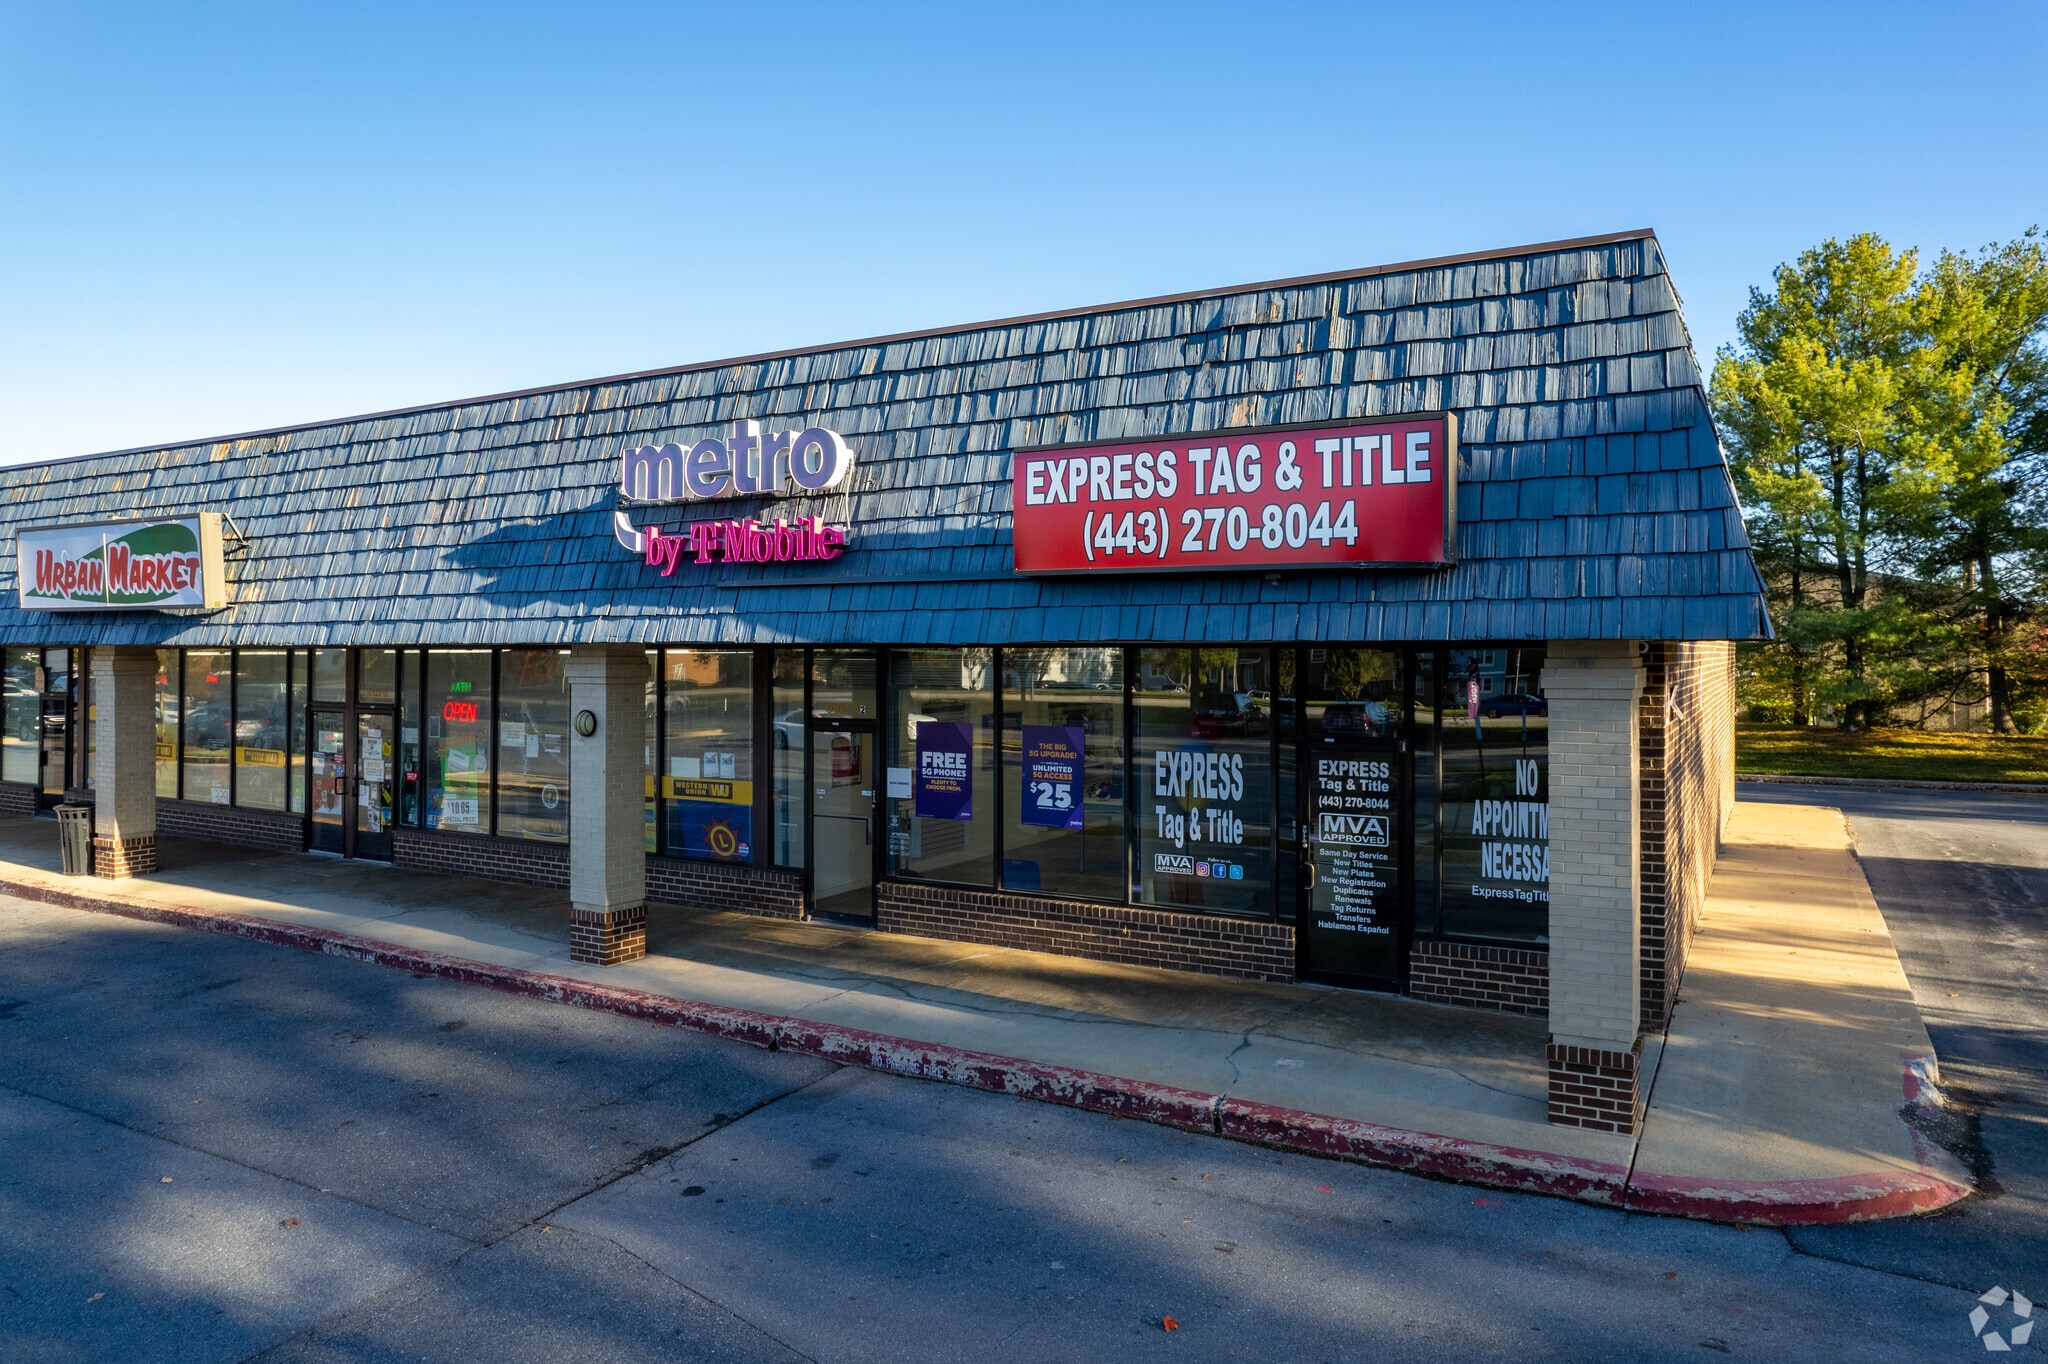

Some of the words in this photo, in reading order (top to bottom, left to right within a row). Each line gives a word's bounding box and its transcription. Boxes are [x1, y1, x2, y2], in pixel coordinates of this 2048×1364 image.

[623, 419, 842, 500] metro
[1025, 450, 1178, 506] EXPRESS
[1188, 442, 1262, 496] TAG
[1275, 440, 1302, 492] &
[1314, 431, 1431, 488] TITLE
[1083, 507, 1170, 562] (443)
[1181, 500, 1359, 552] 270-8044
[645, 525, 688, 577] by
[36, 549, 103, 598] URBAN
[109, 545, 200, 592] MARKET
[444, 701, 478, 723] OPEN
[1039, 742, 1053, 750] THE
[1054, 743, 1067, 751] BIG
[922, 751, 967, 769] FREE
[1040, 751, 1077, 759] UPGRADE!
[922, 767, 933, 775] 5G
[933, 768, 967, 777] PHONES
[1032, 764, 1073, 774] UNLIMITED
[1318, 760, 1390, 779] EXPRESS
[1043, 772, 1073, 781] ACCESS
[1155, 751, 1244, 801] EXPRESS
[1515, 759, 1539, 797] NO
[675, 781, 708, 790] WESTERN
[1318, 777, 1343, 792] Tag
[1346, 778, 1356, 791] &
[1360, 779, 1390, 792] Title
[685, 788, 707, 796] UNION
[1030, 781, 1072, 809] $25
[1318, 795, 1343, 809] (443)
[1345, 796, 1390, 810] 270-8044
[1155, 805, 1185, 848] Tag
[1189, 807, 1202, 842] &
[1206, 808, 1244, 845] Title
[1324, 815, 1385, 836] MVA
[1323, 833, 1385, 844] APPROVED
[1319, 848, 1341, 857] Same
[1342, 850, 1357, 860] Day
[1359, 851, 1389, 861] Service
[1157, 855, 1192, 868] MVA
[1333, 858, 1350, 867] New
[1352, 859, 1374, 869] Titles
[1157, 866, 1192, 874] APPROVED
[1332, 867, 1349, 876] New
[1351, 868, 1375, 878] Plates
[1321, 875, 1338, 883] New
[1339, 877, 1387, 888] Registration
[1333, 885, 1374, 897] Duplicates
[1334, 894, 1372, 906] Renewals
[1330, 903, 1344, 913] Tag
[1346, 904, 1377, 915] Returns
[1335, 912, 1372, 924] Transfers
[1317, 920, 1356, 931] Hablamos
[1357, 924, 1390, 935] Español
